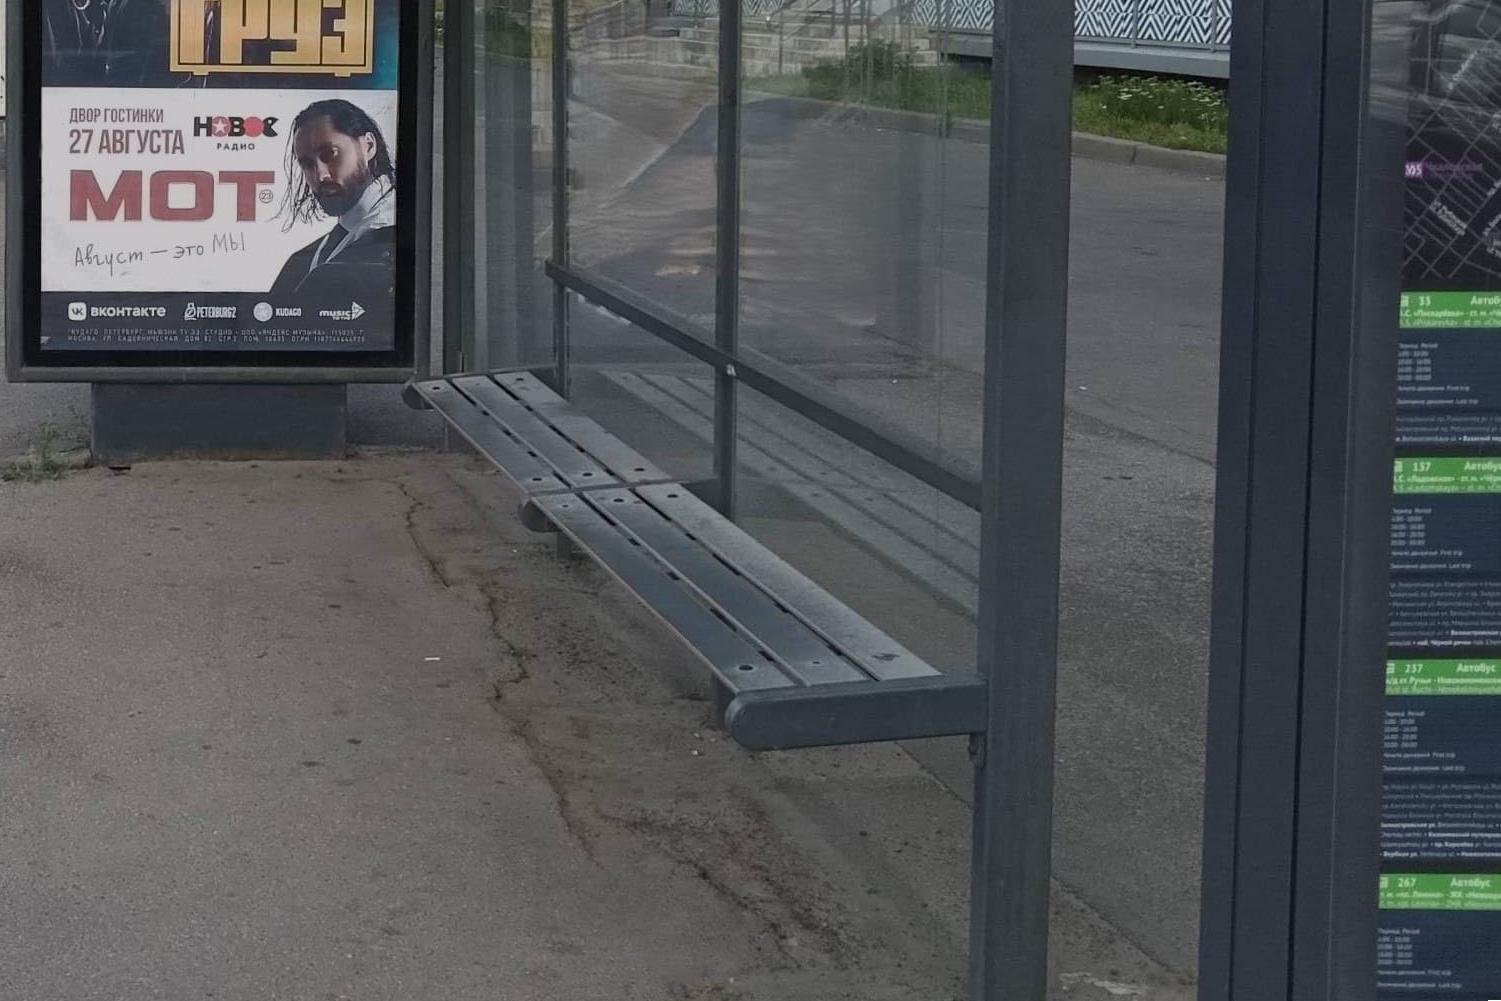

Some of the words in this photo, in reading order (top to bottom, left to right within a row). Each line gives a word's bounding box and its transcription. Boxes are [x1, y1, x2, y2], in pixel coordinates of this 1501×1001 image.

[68, 107, 101, 125] ДВОР
[103, 107, 164, 124] ГОСТИНКИ
[68, 129, 92, 155] 27
[98, 129, 185, 156] АВГУСТА
[216, 143, 256, 152] РАДИО
[69, 169, 275, 223] МОТ
[74, 243, 144, 276] Август
[173, 243, 205, 259] это
[212, 231, 246, 253] МЫ
[1470, 295, 1501, 307] Автоб
[90, 305, 167, 318] вконтакте
[1456, 662, 1497, 675] Автобус
[1396, 877, 1418, 888] 267
[1450, 877, 1492, 889] Автобус
